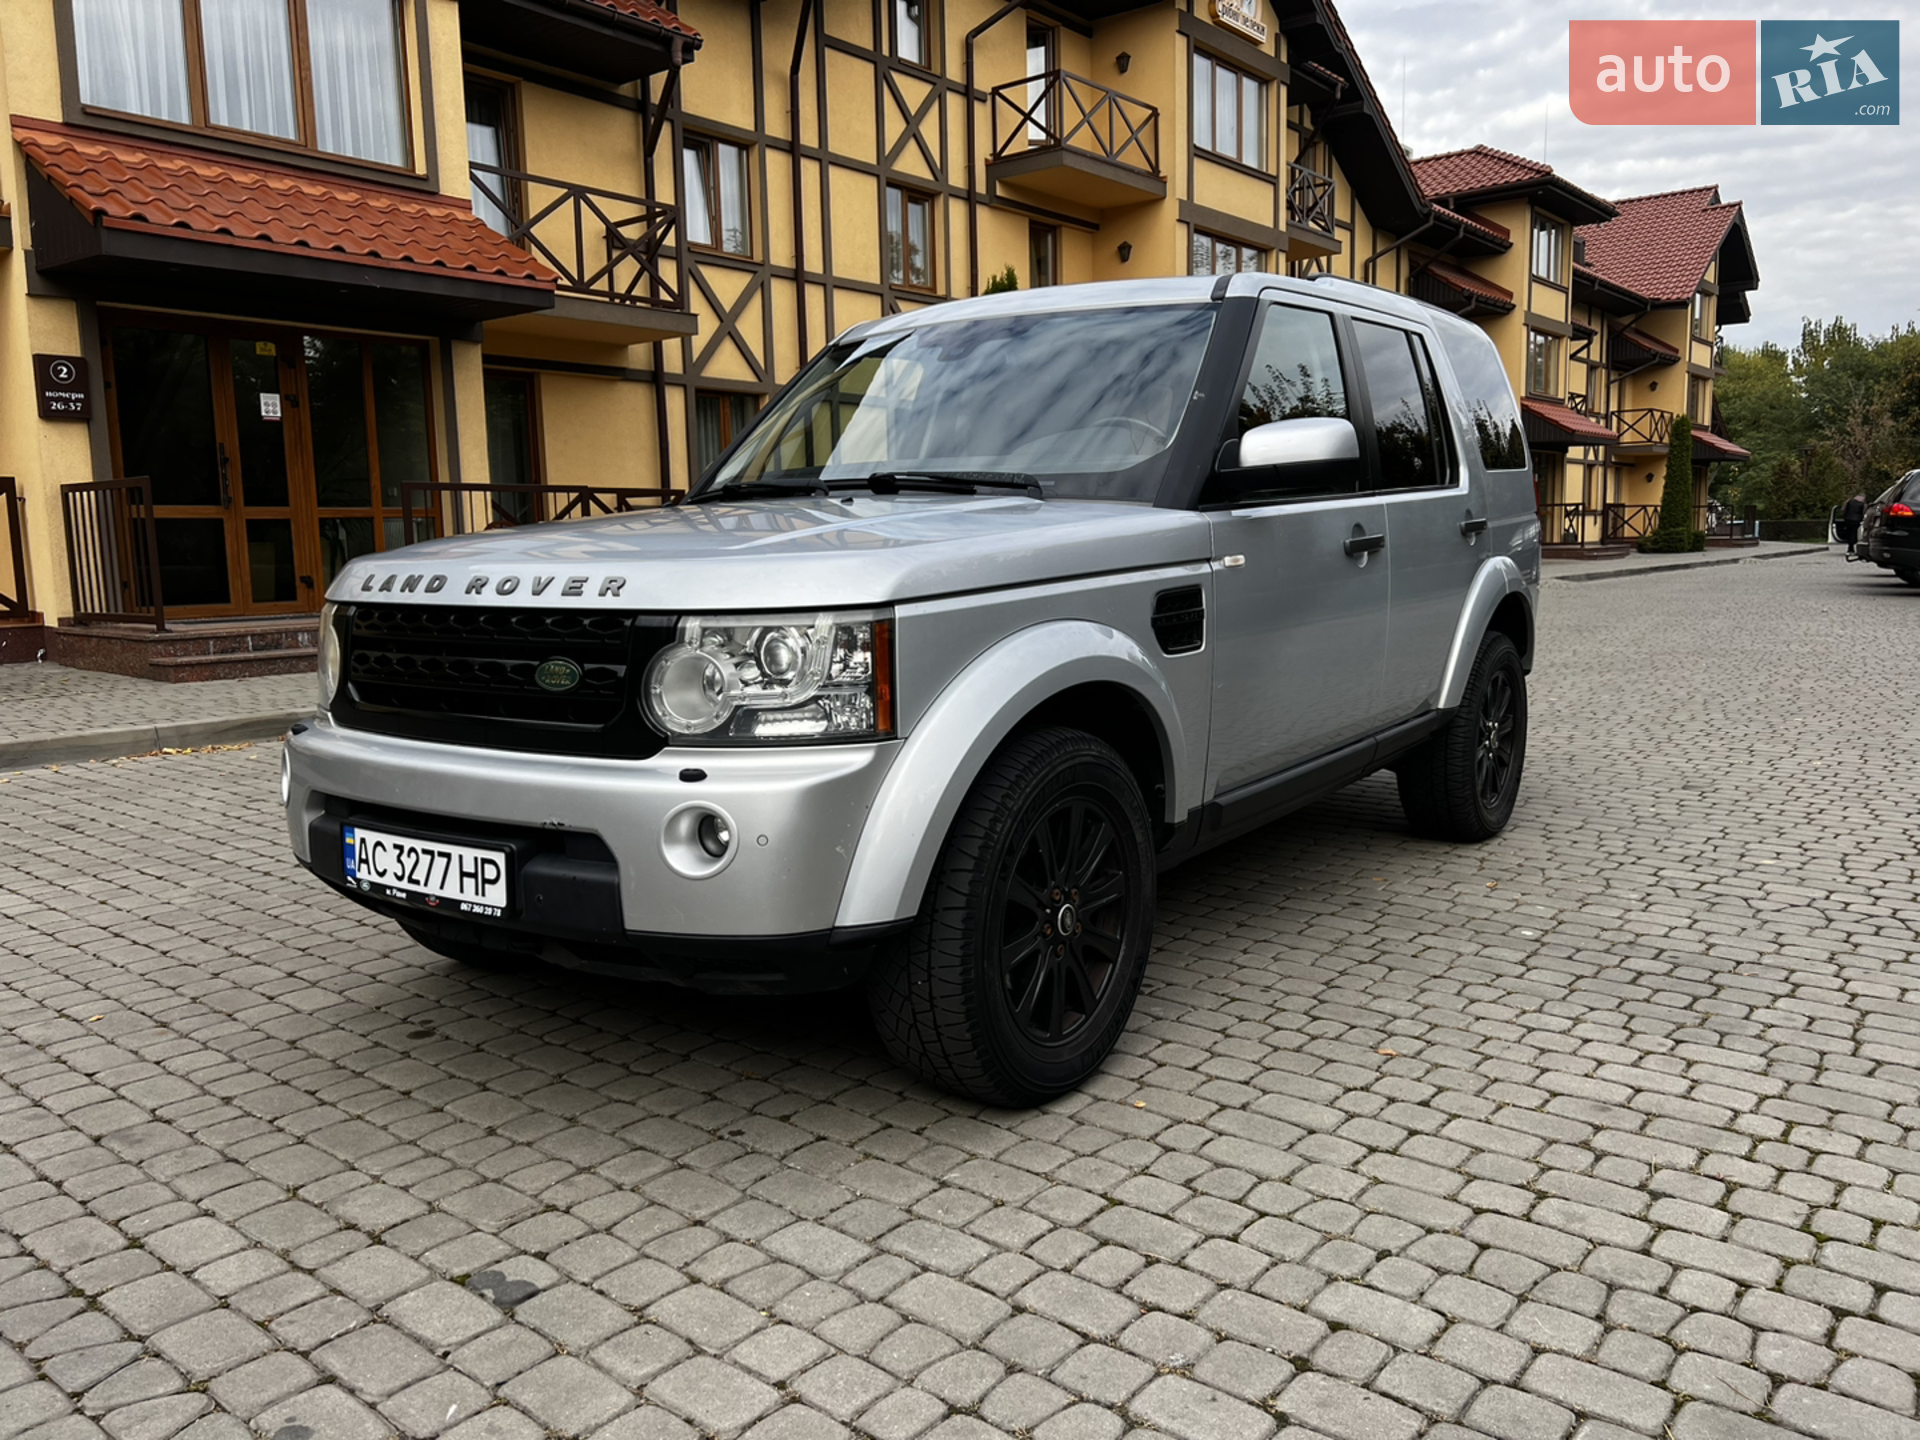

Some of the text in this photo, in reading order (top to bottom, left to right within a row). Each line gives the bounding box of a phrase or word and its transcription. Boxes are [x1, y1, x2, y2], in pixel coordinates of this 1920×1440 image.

[57, 365, 68, 378] 2
[45, 391, 85, 400] номери
[50, 401, 82, 411] 26-37
[360, 574, 627, 597] LAND ROVER
[346, 858, 355, 870] UA
[357, 837, 501, 898] AC 3277 HP
